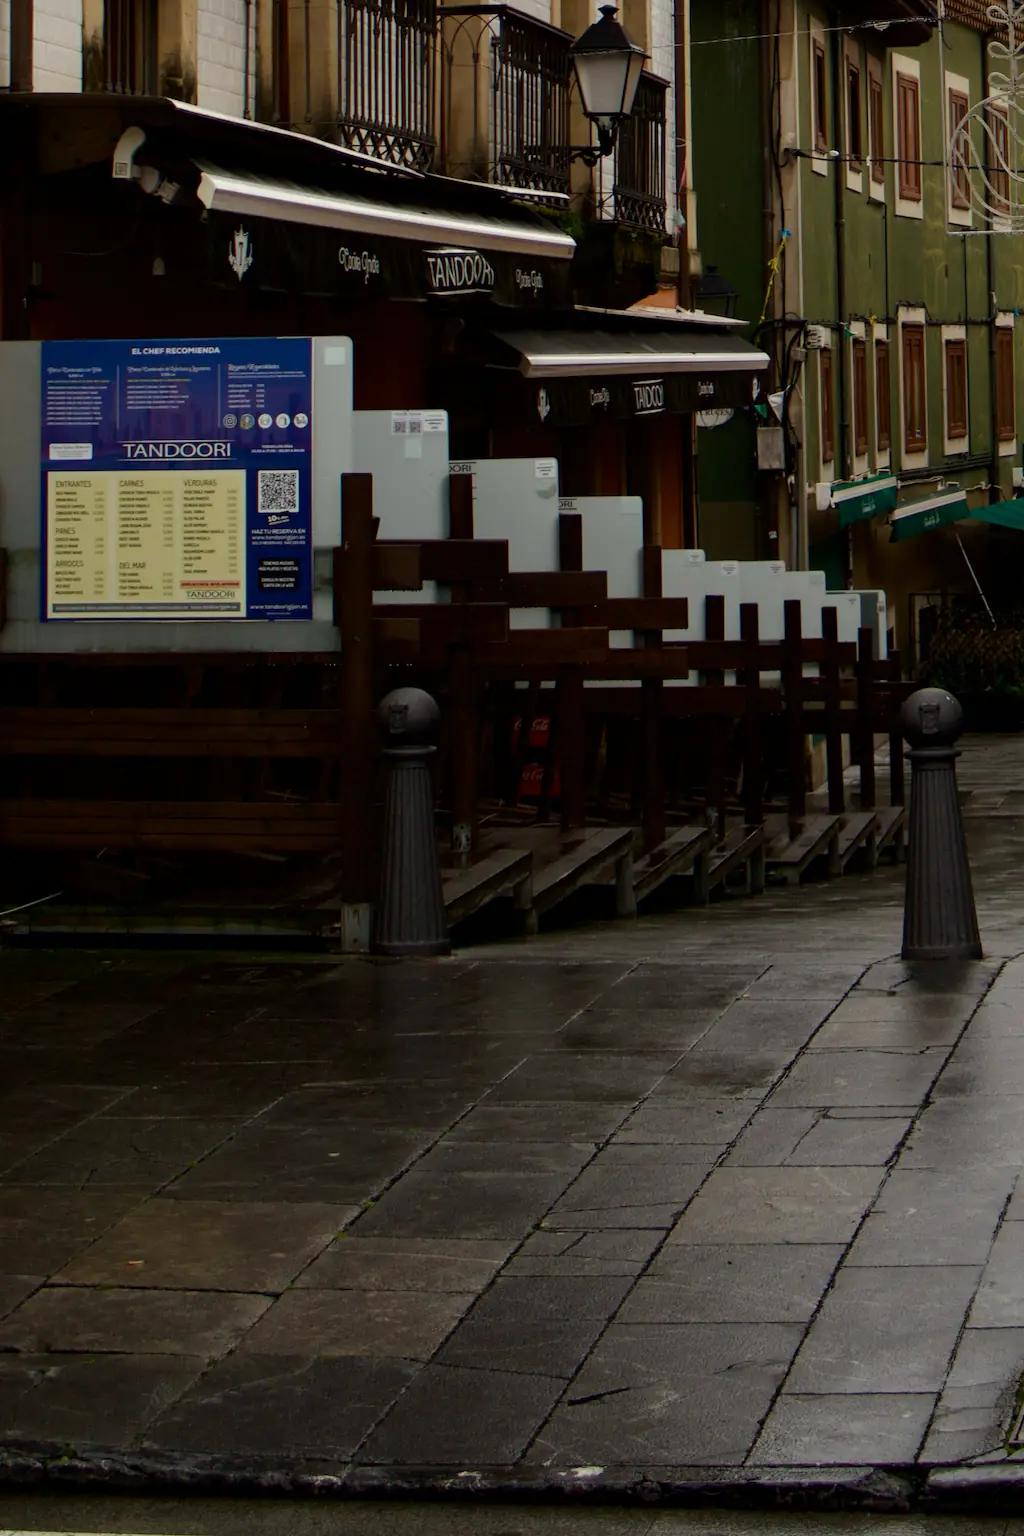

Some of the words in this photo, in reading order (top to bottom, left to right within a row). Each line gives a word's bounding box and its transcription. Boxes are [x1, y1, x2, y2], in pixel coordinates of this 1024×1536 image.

[166, 347, 221, 355] RECOMIENDA
[122, 443, 232, 458] TANDOORI
[55, 480, 92, 488] ENTRANTES
